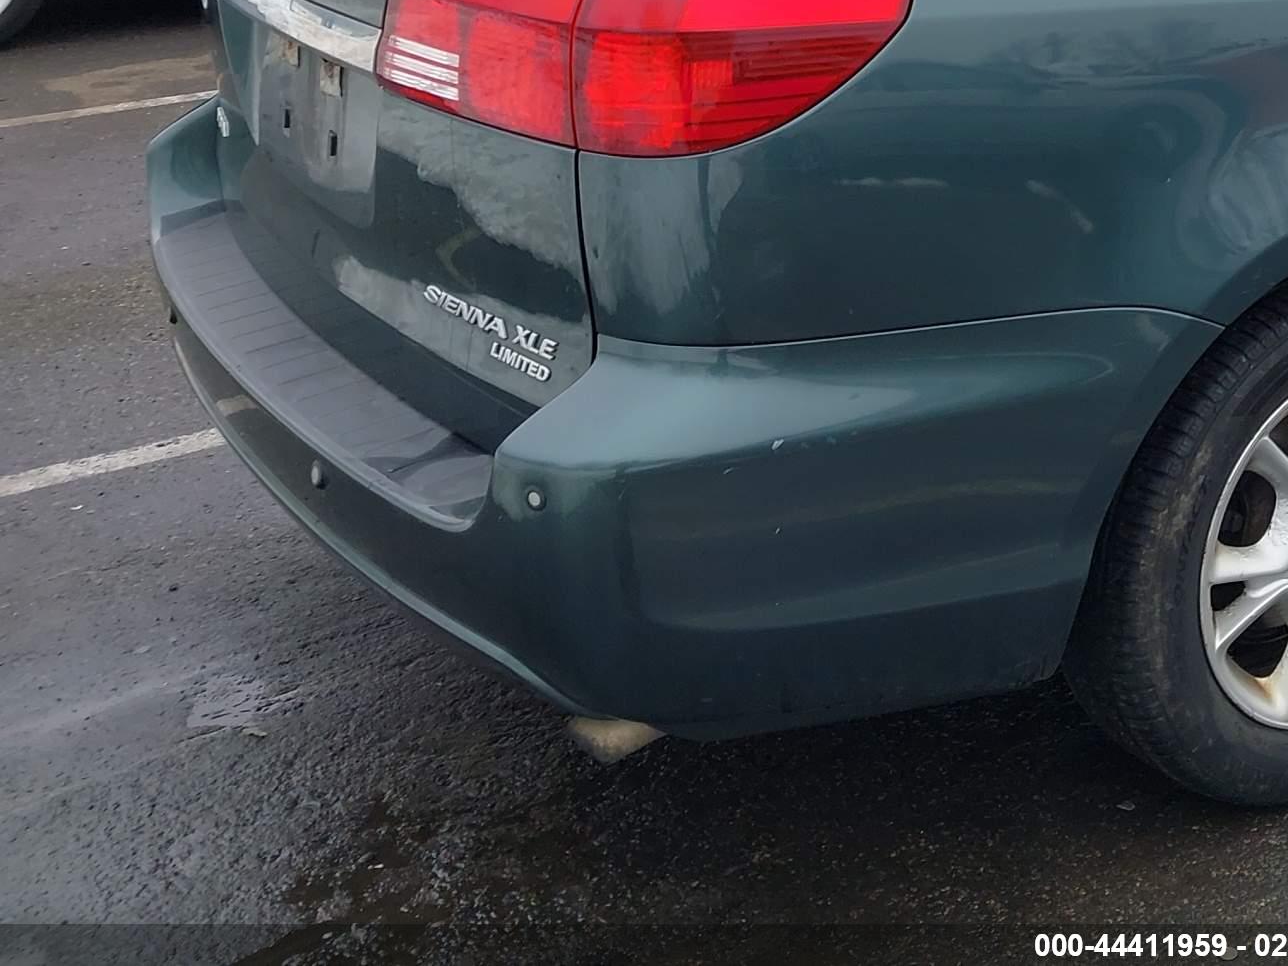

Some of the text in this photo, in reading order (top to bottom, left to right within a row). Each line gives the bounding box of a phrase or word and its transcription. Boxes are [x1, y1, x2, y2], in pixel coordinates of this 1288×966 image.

[423, 284, 559, 360] SIENNA XLE
[490, 341, 551, 382] LIMITED
